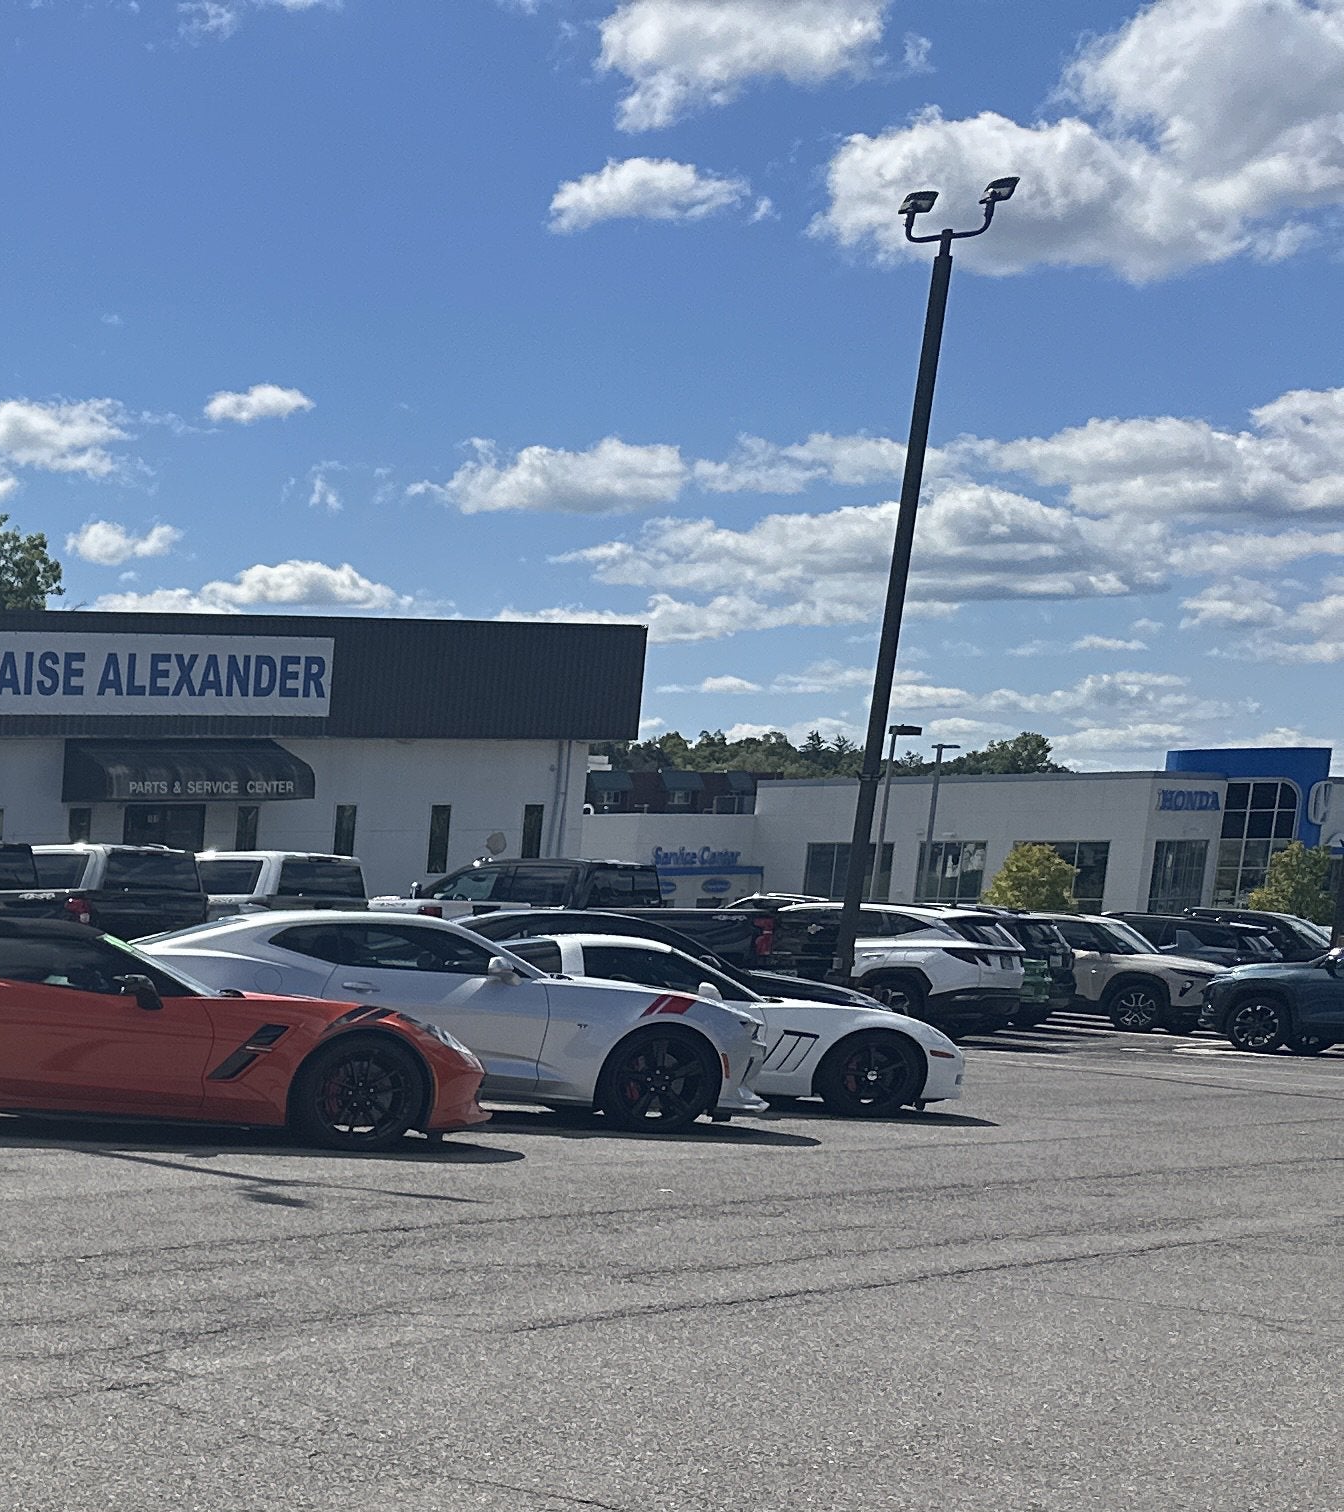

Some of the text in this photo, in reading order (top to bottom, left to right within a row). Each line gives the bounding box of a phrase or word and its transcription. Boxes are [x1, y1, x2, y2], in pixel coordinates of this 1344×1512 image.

[96, 652, 326, 698] ALEXANDER
[129, 780, 294, 794] PARTS & SERVICE CENTER
[1159, 789, 1220, 811] HONDA
[654, 846, 741, 865] Service Center
